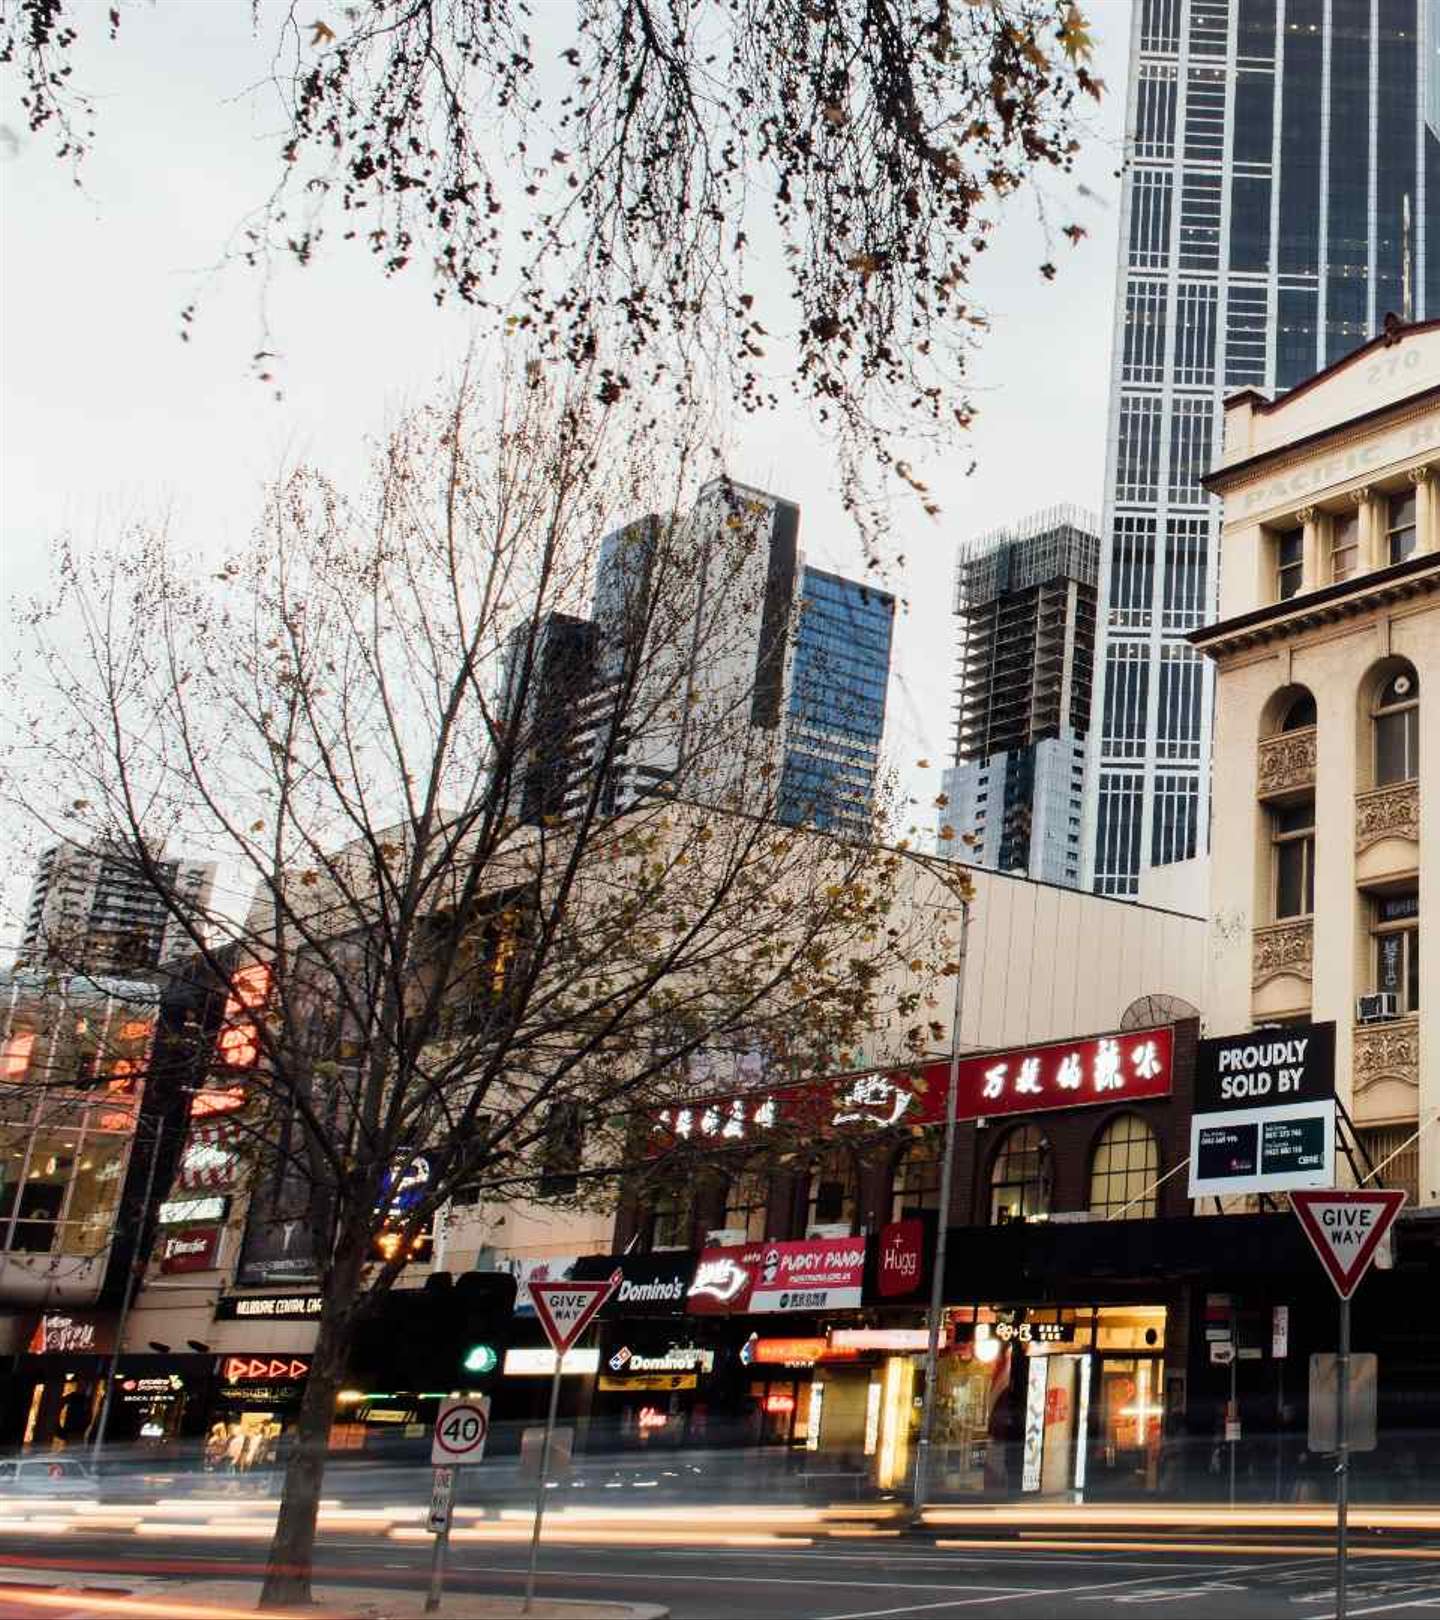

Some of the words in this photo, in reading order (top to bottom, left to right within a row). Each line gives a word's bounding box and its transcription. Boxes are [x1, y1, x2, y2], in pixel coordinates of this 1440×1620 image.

[1366, 349, 1422, 385] 270
[1242, 446, 1383, 510] PACIFIC
[1218, 1038, 1309, 1073] PROUDLY
[1221, 1071, 1272, 1099] SOLD
[1277, 1067, 1305, 1093] BY
[1322, 1208, 1372, 1228] GIVE
[1331, 1229, 1365, 1245] WAY
[884, 1249, 917, 1275] Hugg
[618, 1275, 684, 1301] Domino's
[549, 1295, 587, 1308] GIVE
[554, 1308, 580, 1321] WAY
[629, 1354, 696, 1370] Domino's
[443, 1417, 479, 1442] 40
